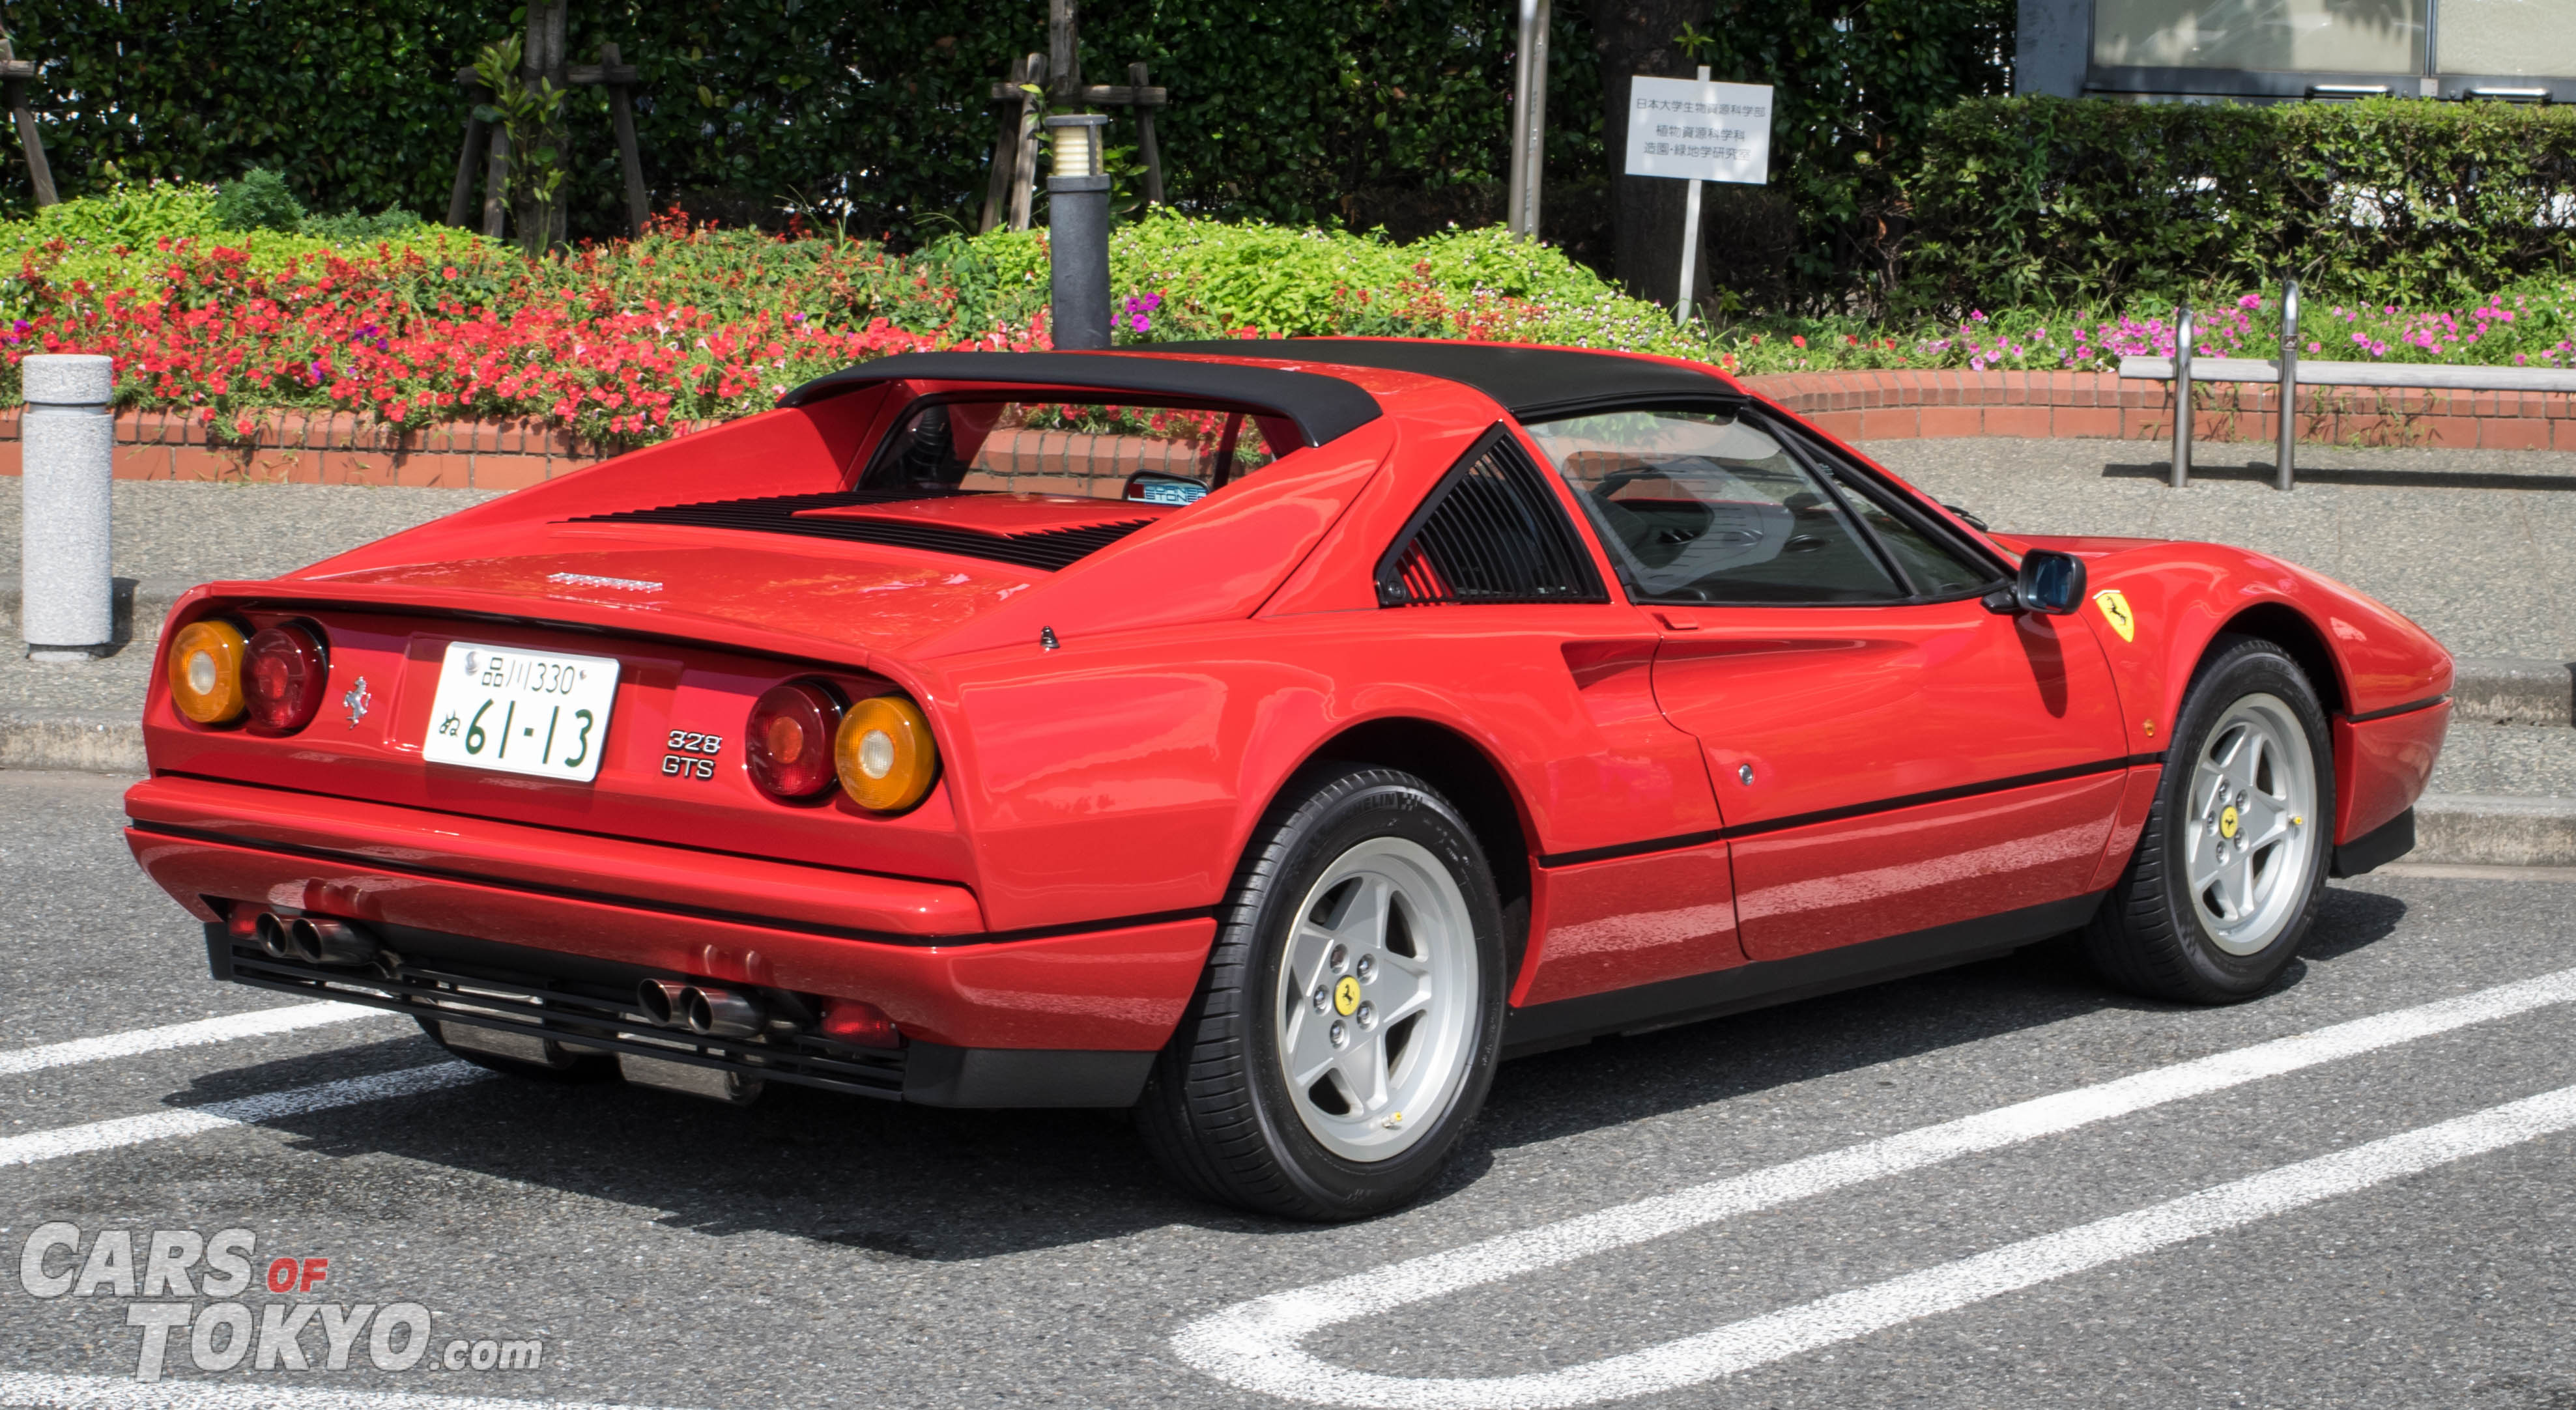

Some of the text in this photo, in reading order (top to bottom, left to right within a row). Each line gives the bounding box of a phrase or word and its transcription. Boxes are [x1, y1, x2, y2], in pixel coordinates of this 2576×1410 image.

[1636, 98, 1766, 118] 日本大学生物資源科学部
[1656, 124, 1745, 141] 植物資源科学科
[439, 709, 461, 737] ぬ
[667, 729, 723, 754] 328
[662, 755, 715, 780] GTS
